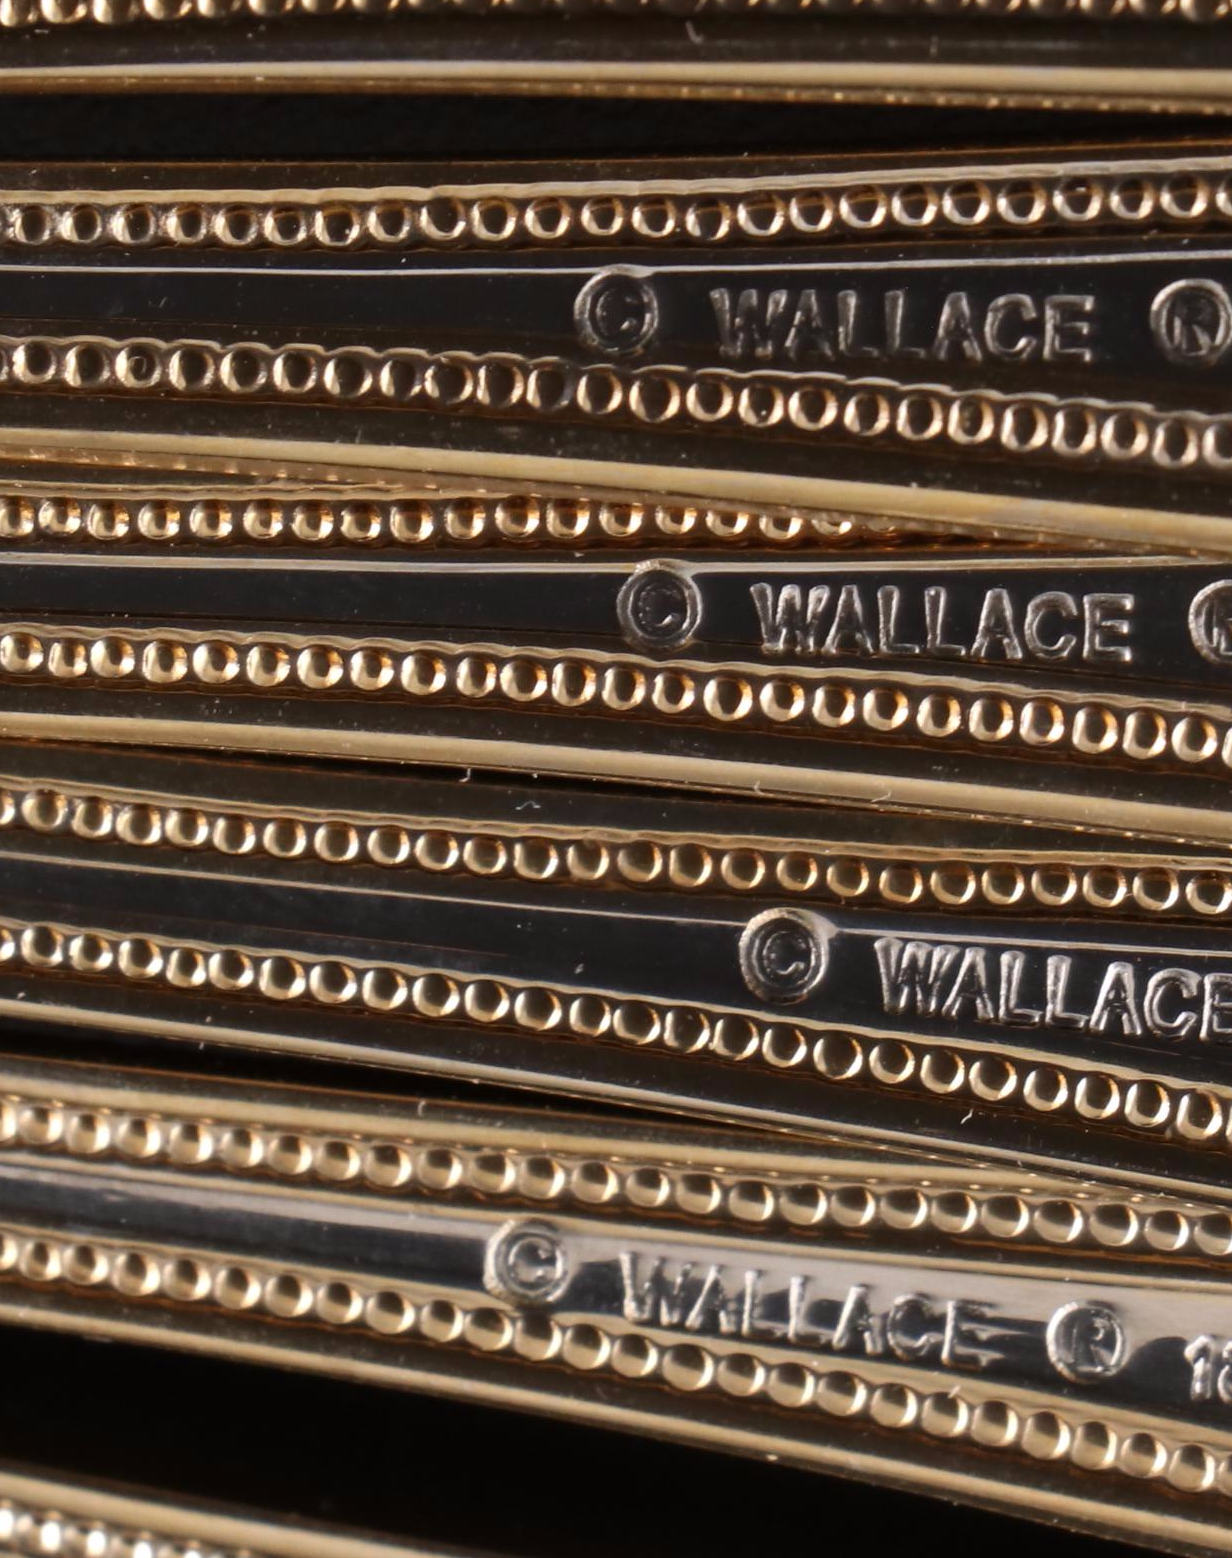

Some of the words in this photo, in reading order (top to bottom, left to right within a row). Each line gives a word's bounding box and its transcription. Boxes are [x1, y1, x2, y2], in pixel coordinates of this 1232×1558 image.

[710, 288, 1096, 364] WALLACE
[750, 582, 1136, 664] WALLACE
[620, 1250, 1000, 1370] WALLACE
